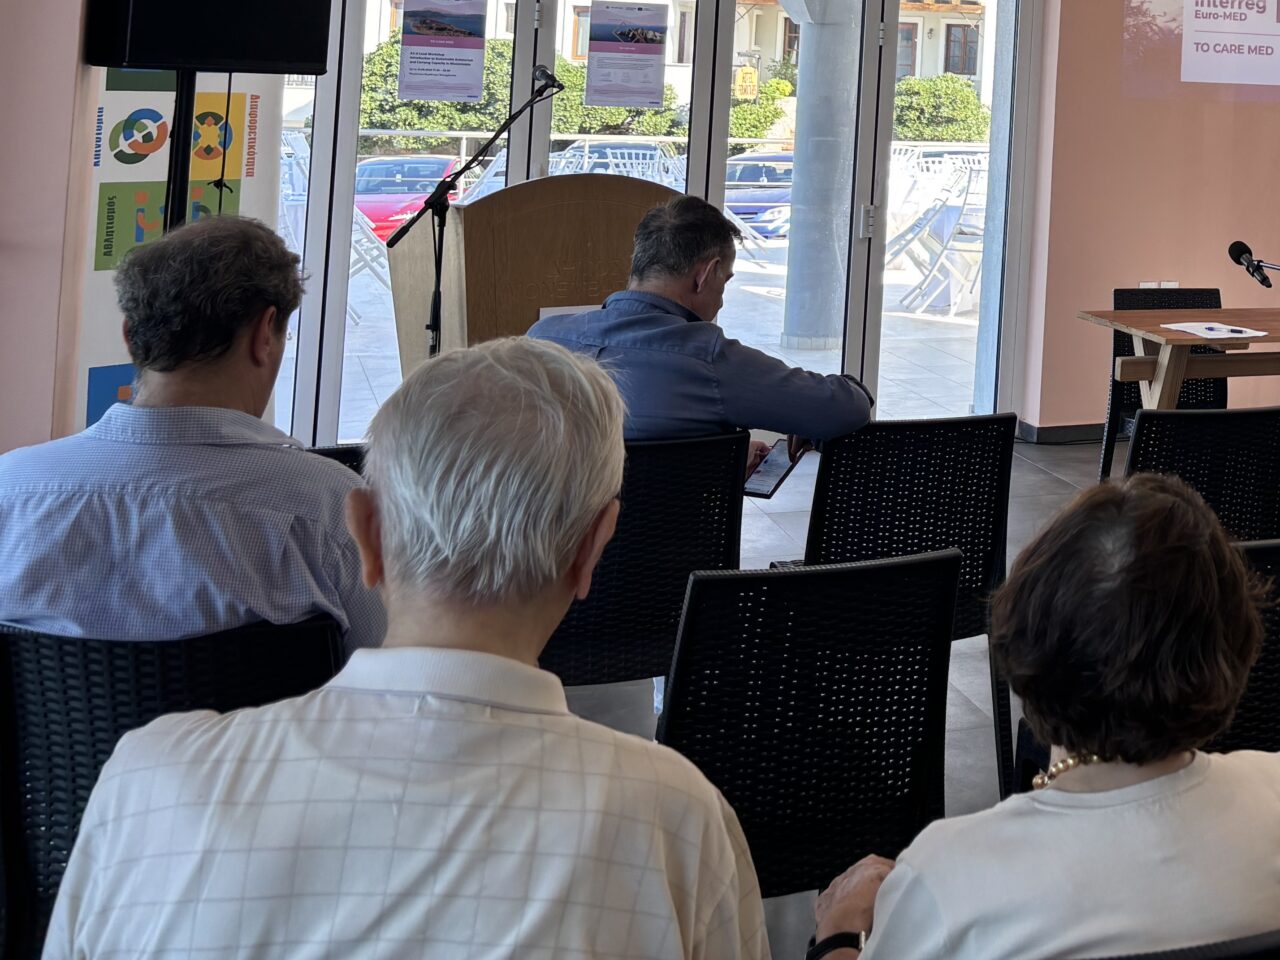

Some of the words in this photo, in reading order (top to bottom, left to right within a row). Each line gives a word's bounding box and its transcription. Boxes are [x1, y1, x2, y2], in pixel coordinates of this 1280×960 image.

[1194, 9, 1248, 22] Euro-MED
[1193, 42, 1210, 53] TO
[1213, 43, 1245, 54] CARE
[1247, 44, 1274, 56] MED
[103, 195, 117, 257] Αθλητισμός
